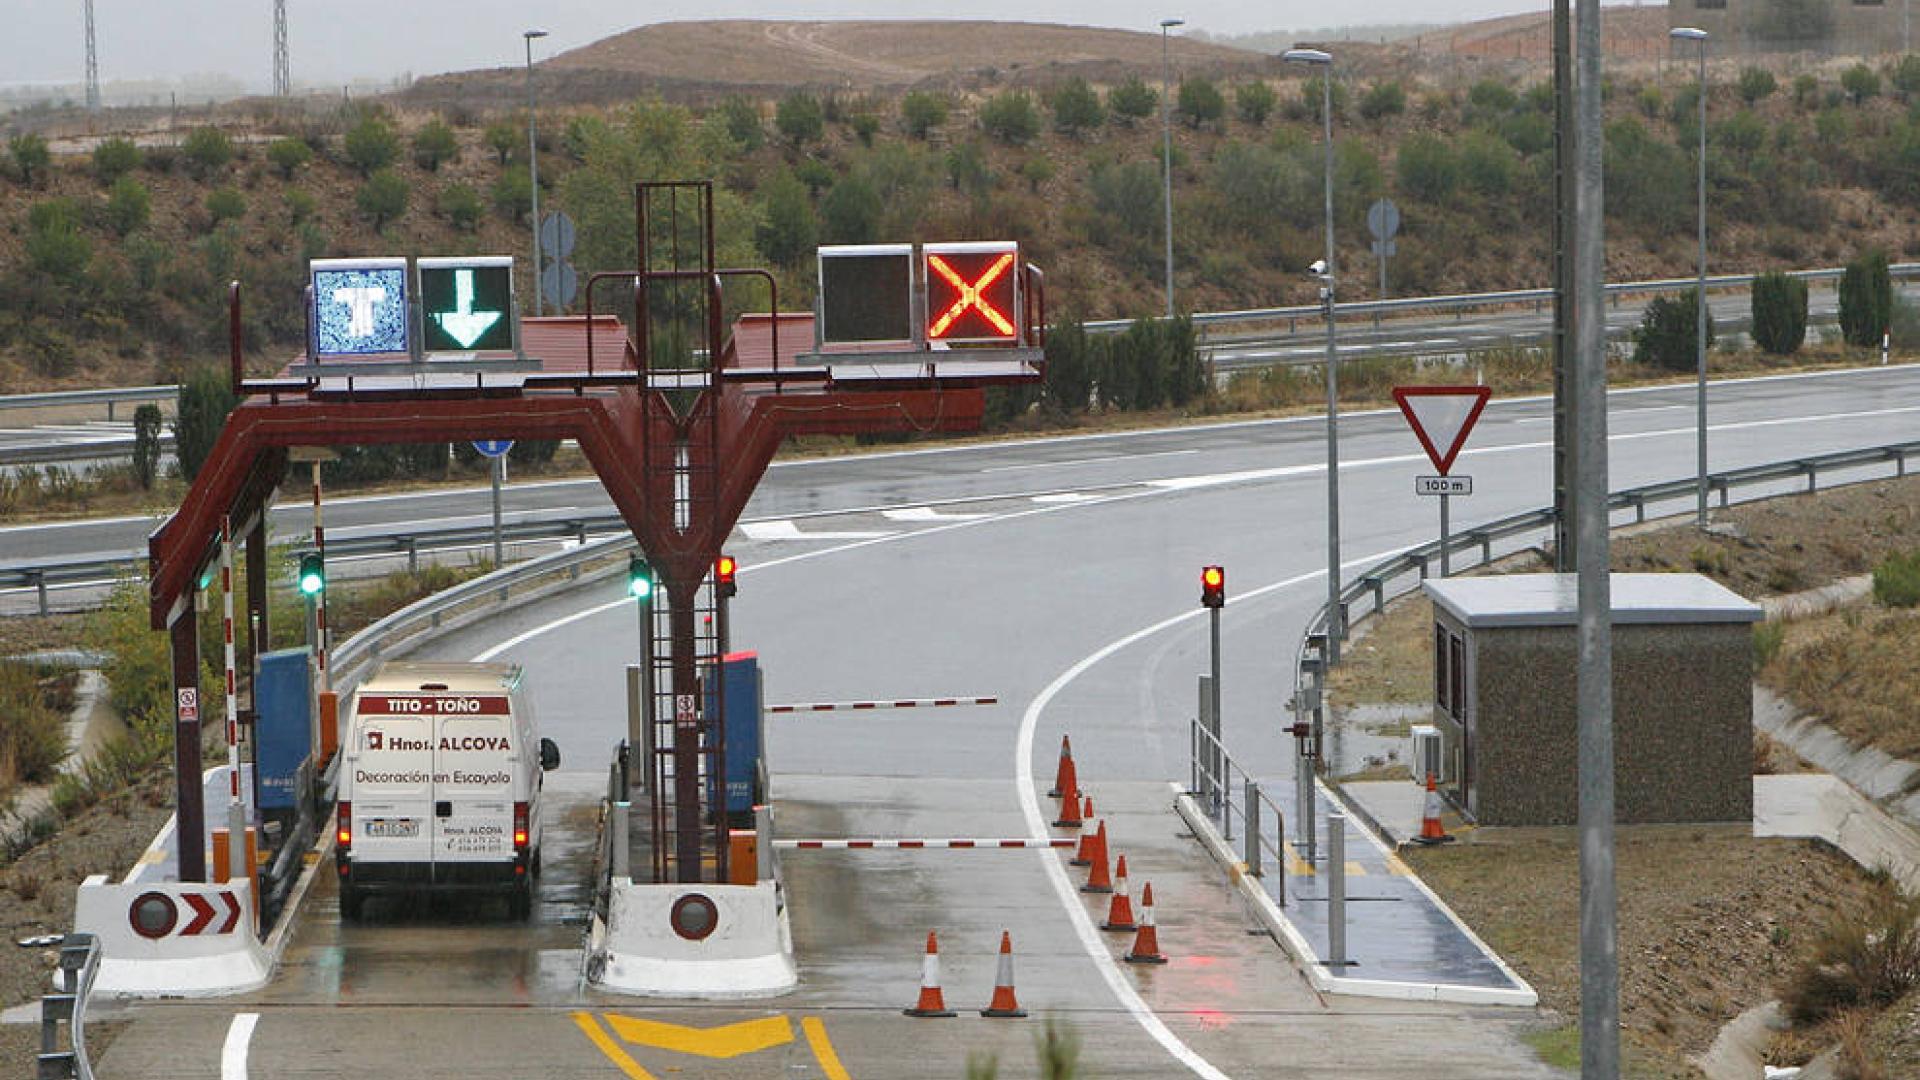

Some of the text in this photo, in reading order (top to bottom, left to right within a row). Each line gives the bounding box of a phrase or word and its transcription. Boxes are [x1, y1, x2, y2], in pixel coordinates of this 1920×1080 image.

[1426, 480, 1449, 490] 100
[388, 699, 422, 712] TITO
[436, 697, 480, 712] TOÑO
[389, 738, 510, 750] Hnos. ALCOYA
[356, 770, 510, 785] Decoración en Escayola
